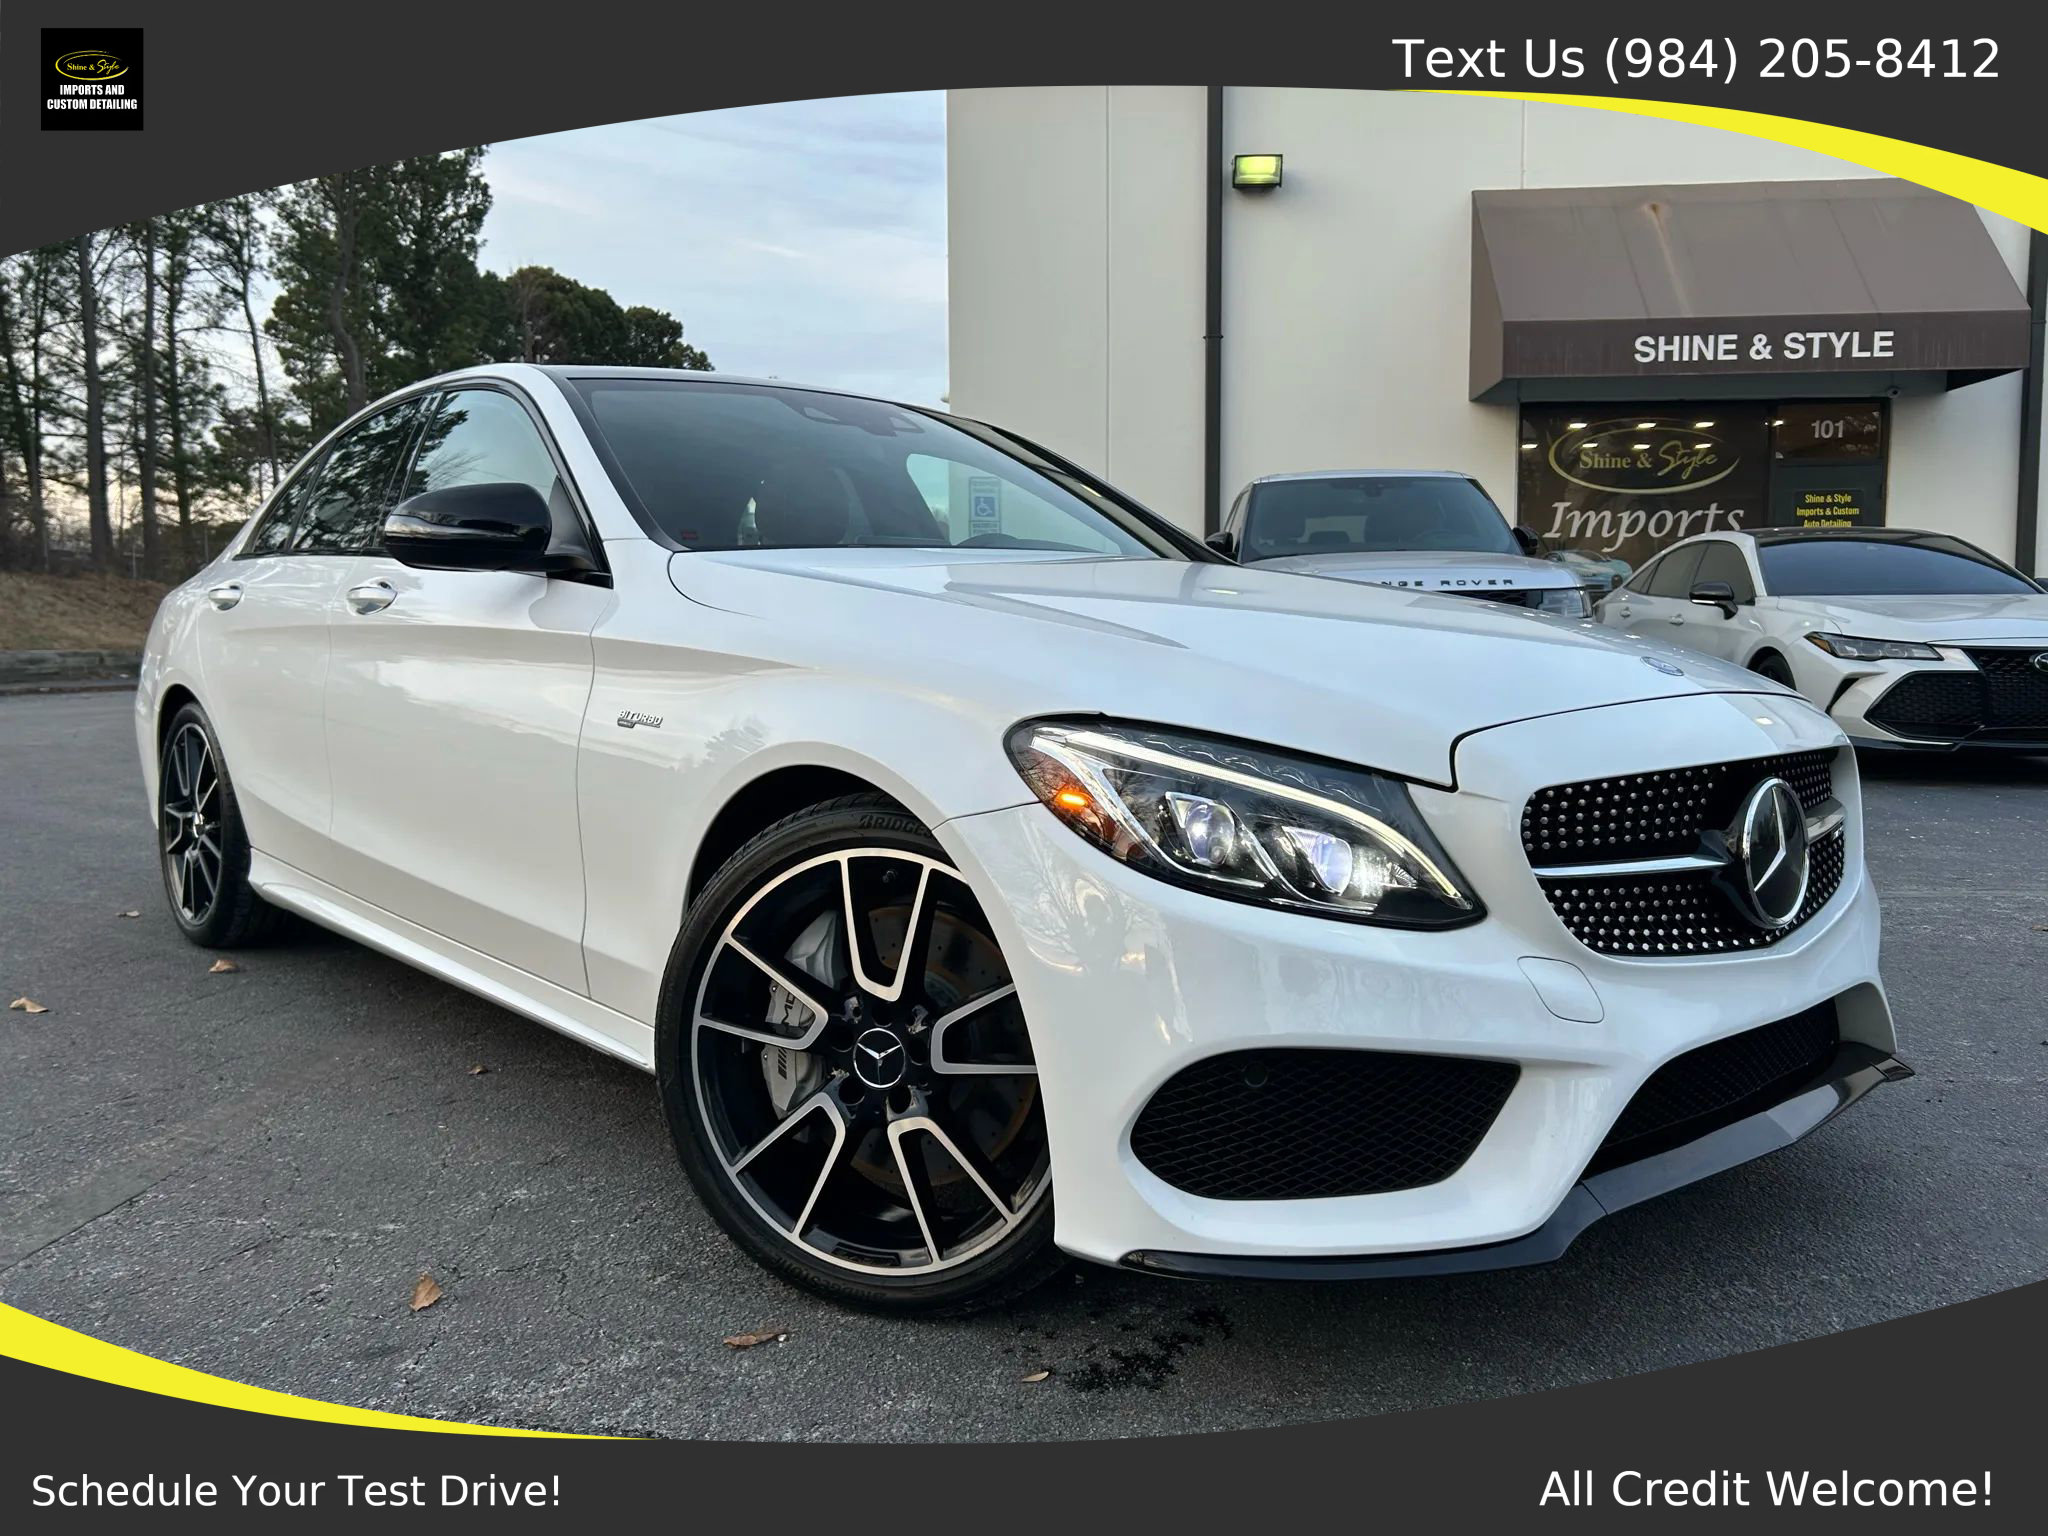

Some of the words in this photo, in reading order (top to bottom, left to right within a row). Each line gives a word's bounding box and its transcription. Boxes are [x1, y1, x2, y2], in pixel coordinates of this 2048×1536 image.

[1634, 334, 1738, 363] SHINE
[1749, 333, 1773, 360] &
[1783, 330, 1894, 359] STYLE
[1811, 420, 1844, 438] 101
[1579, 451, 1631, 469] Shine
[1636, 452, 1651, 469] &
[1657, 440, 1718, 480] Style
[1805, 494, 1825, 503] Shine
[1826, 495, 1832, 503] &
[1833, 493, 1852, 504] Style
[1796, 507, 1824, 517] Imports
[1825, 508, 1832, 516] &
[1833, 506, 1860, 515] Custom
[1542, 501, 1745, 552] Imports
[1440, 579, 1514, 587] ROVER
[618, 710, 664, 726] BITURBO
